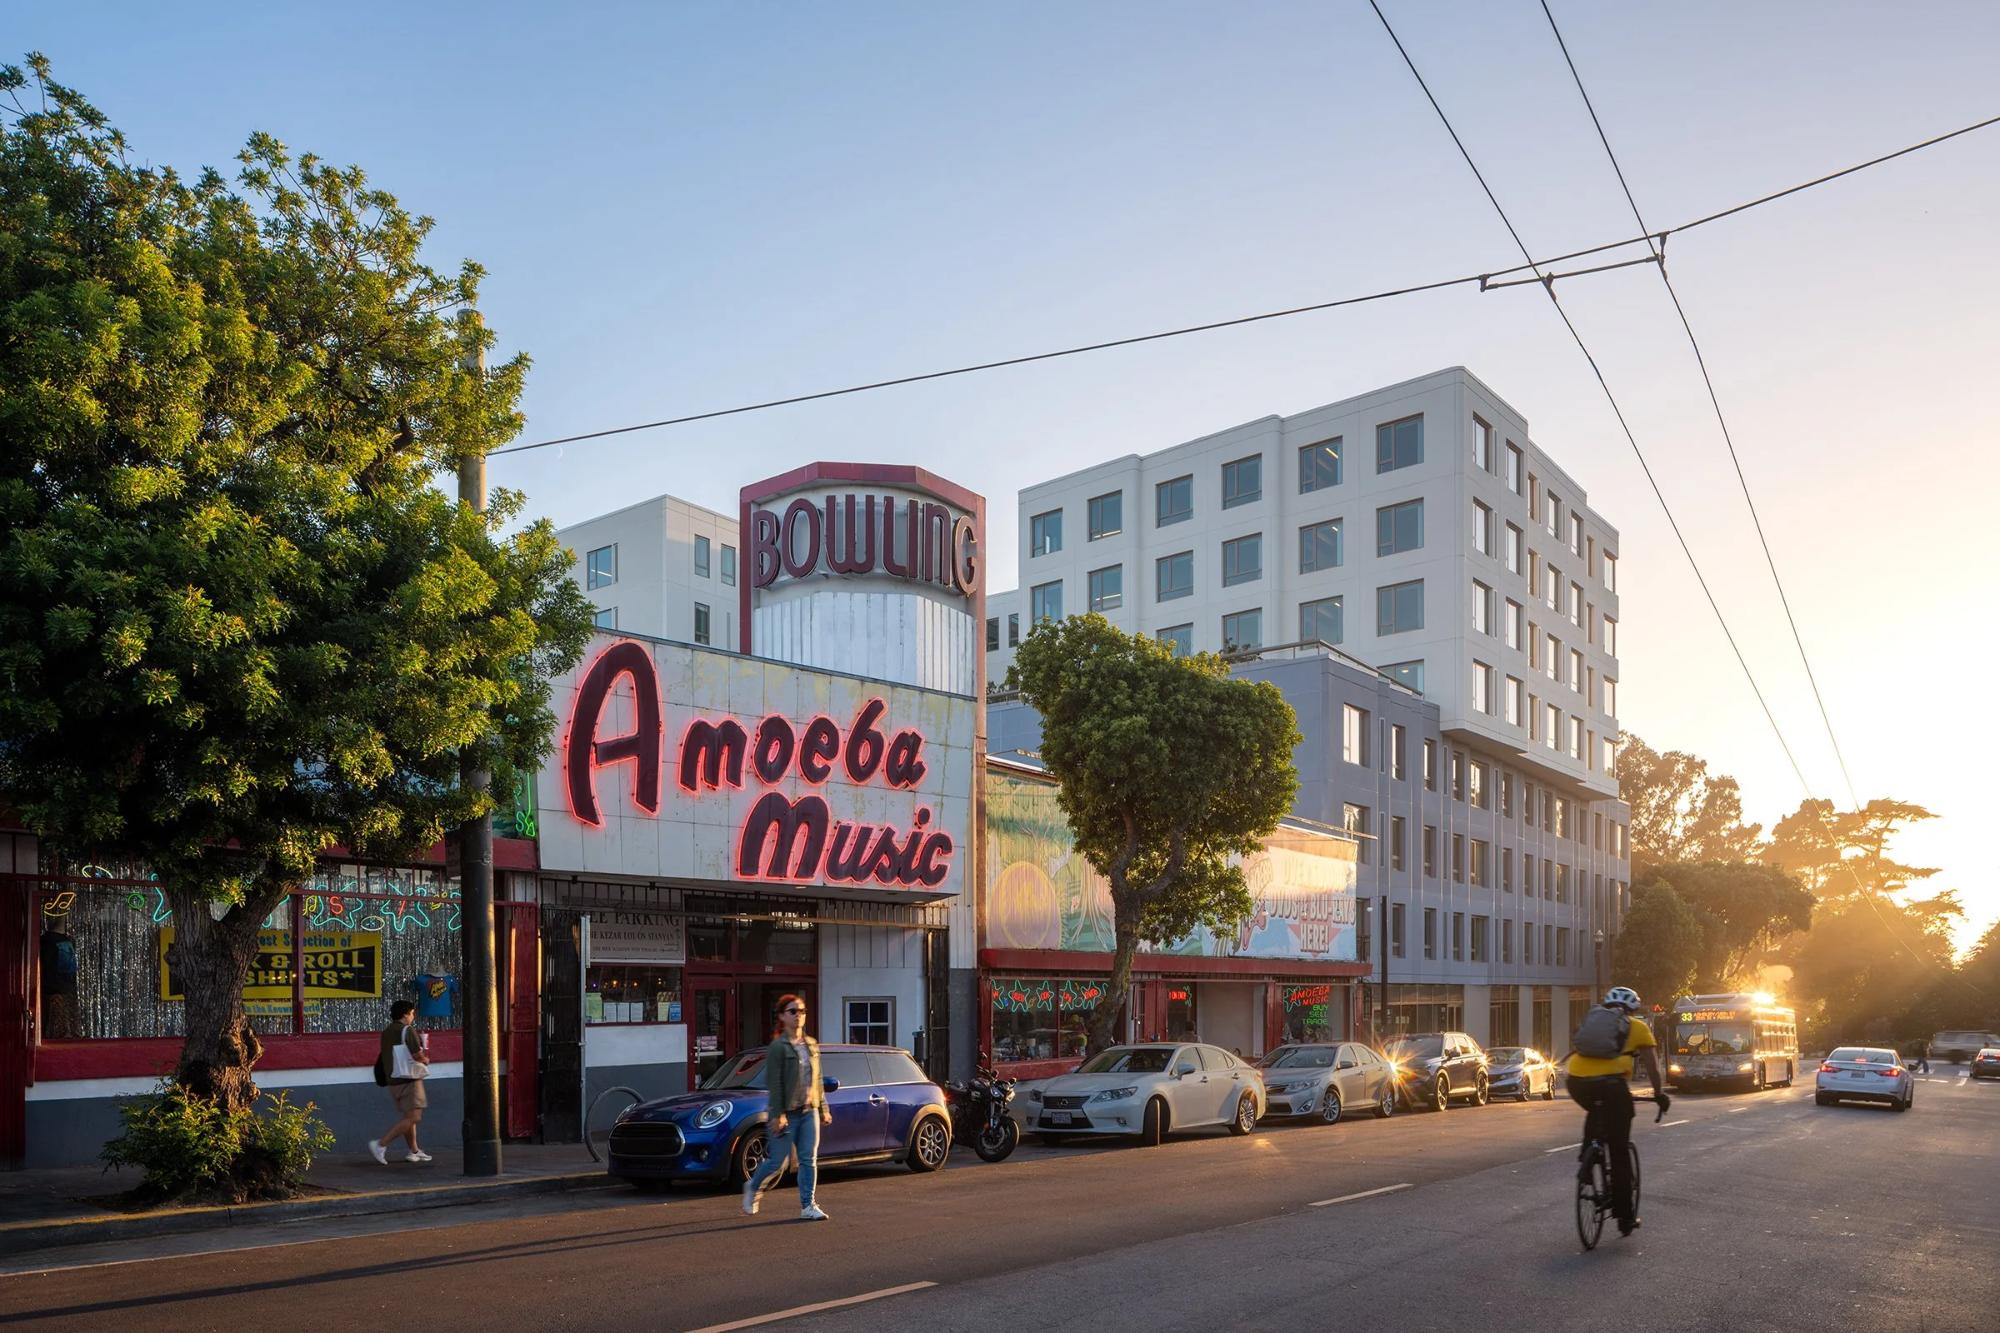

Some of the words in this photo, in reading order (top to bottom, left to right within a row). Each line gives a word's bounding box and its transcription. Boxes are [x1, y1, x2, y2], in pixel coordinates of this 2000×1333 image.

[753, 494, 977, 597] BOWLING
[567, 640, 927, 828] Amoeba
[737, 791, 953, 888] Music
[283, 933, 336, 948] Section
[340, 934, 351, 948] of
[1300, 924, 1330, 954] HERE!
[271, 955, 290, 969] &
[1290, 985, 1329, 1002] AMOEBA
[1303, 995, 1328, 1005] MUSIC
[1681, 1012, 1693, 1022] 33
